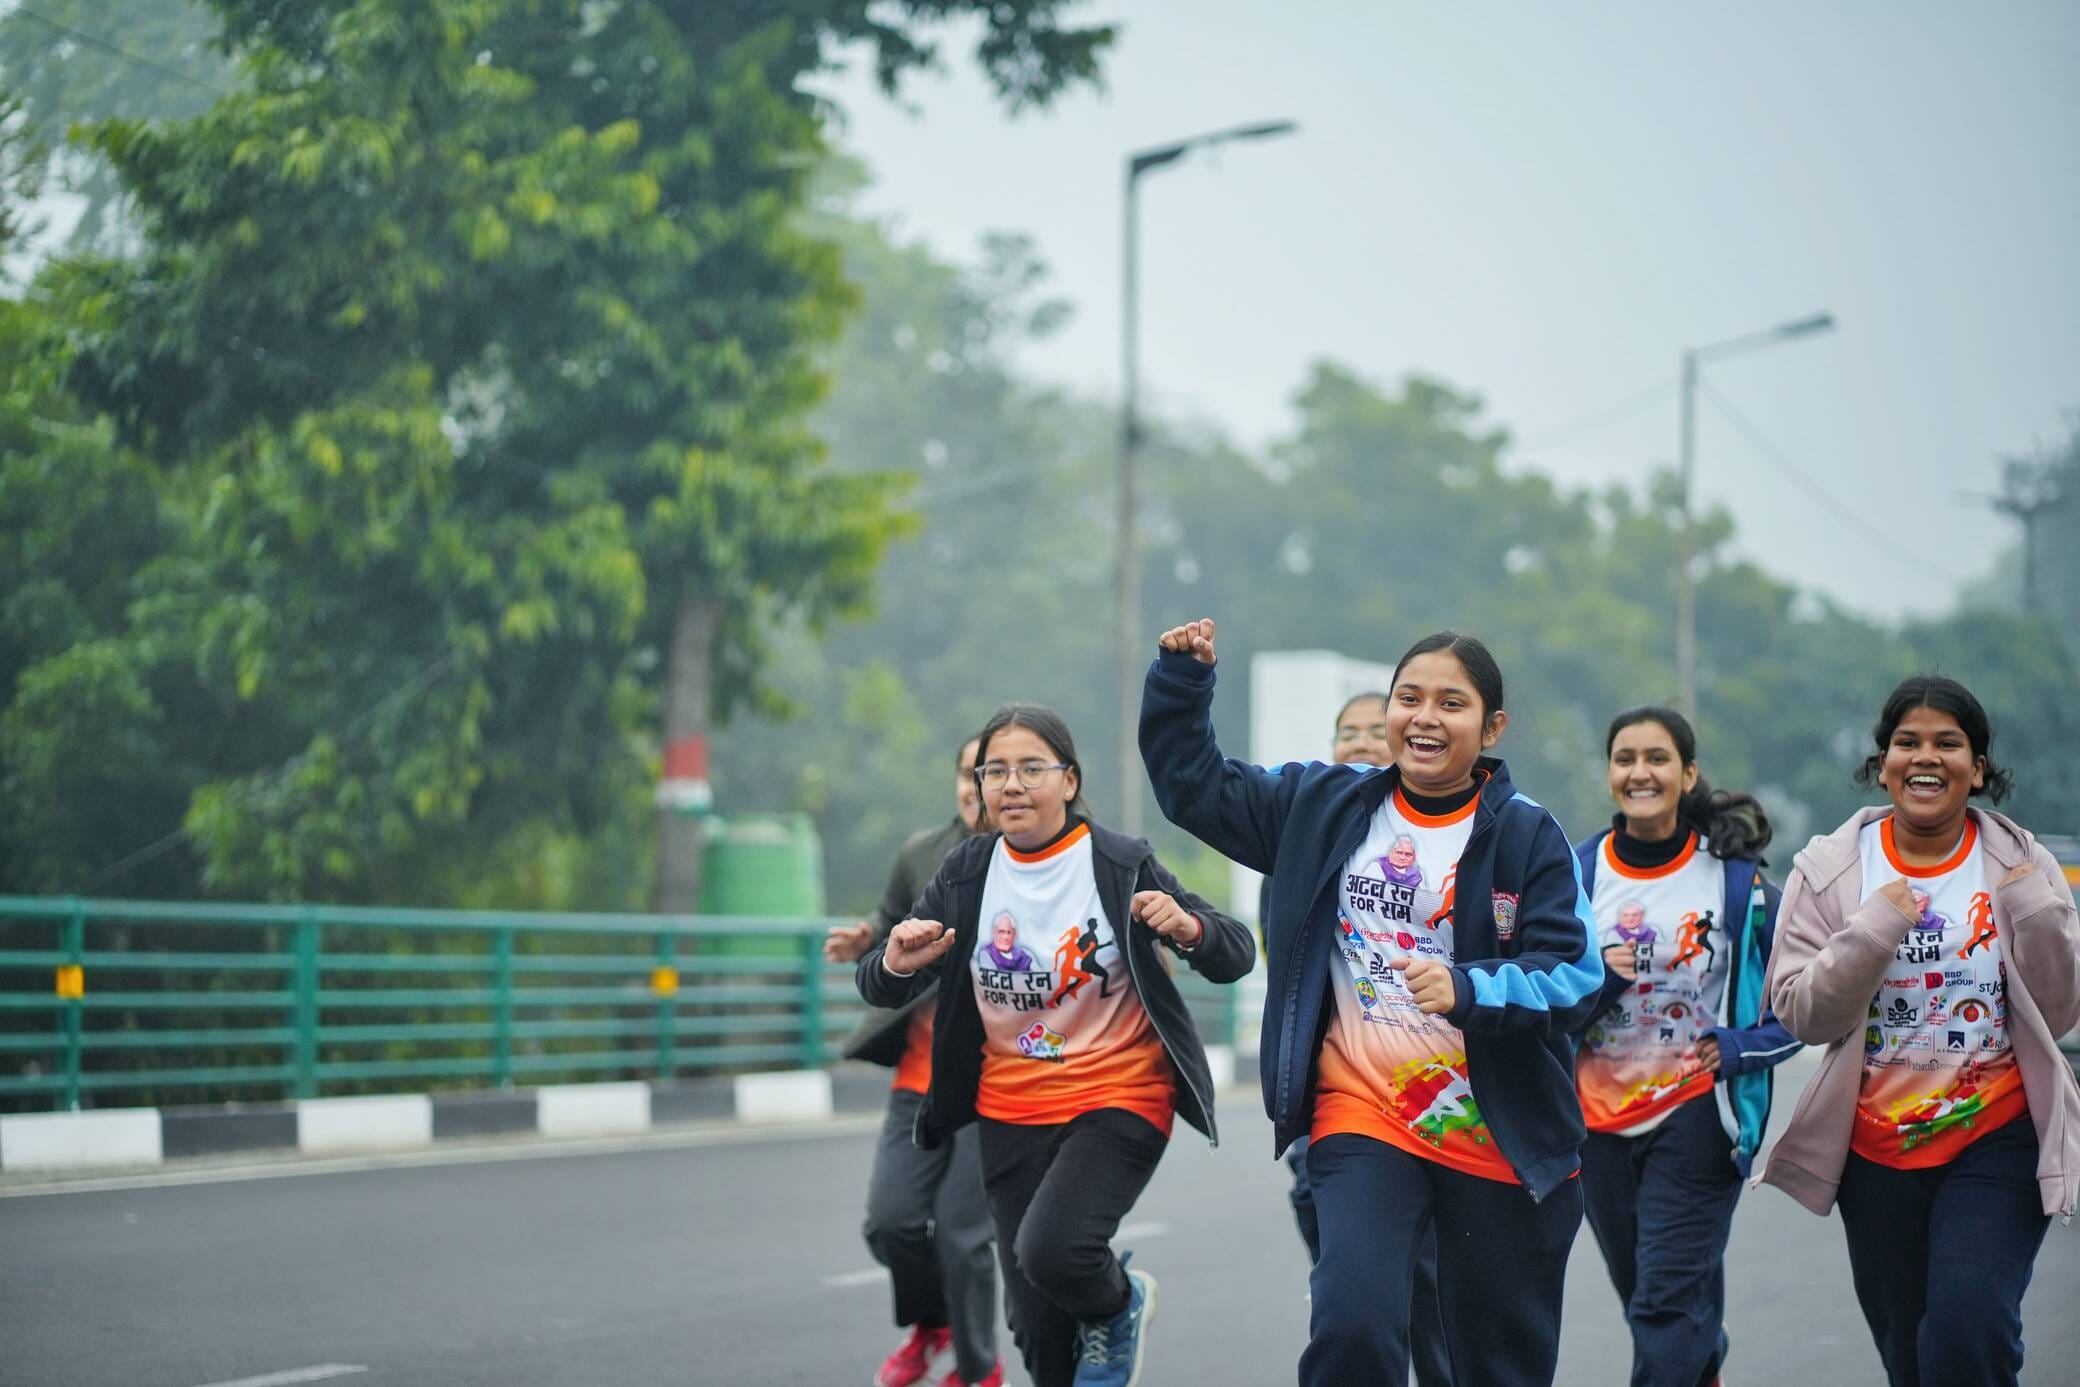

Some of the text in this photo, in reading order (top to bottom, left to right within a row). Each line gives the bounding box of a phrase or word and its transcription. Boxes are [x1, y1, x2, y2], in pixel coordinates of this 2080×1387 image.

[1346, 874, 1416, 906] अटल रन
[1350, 896, 1413, 923] FOR राम
[1913, 930, 1943, 945] रन
[1417, 946, 1443, 954] GROUP
[1904, 945, 1940, 963] राम
[979, 968, 1053, 991] अटल रन
[1945, 979, 1974, 987] GROUP
[984, 990, 1044, 1011] FOR राम
